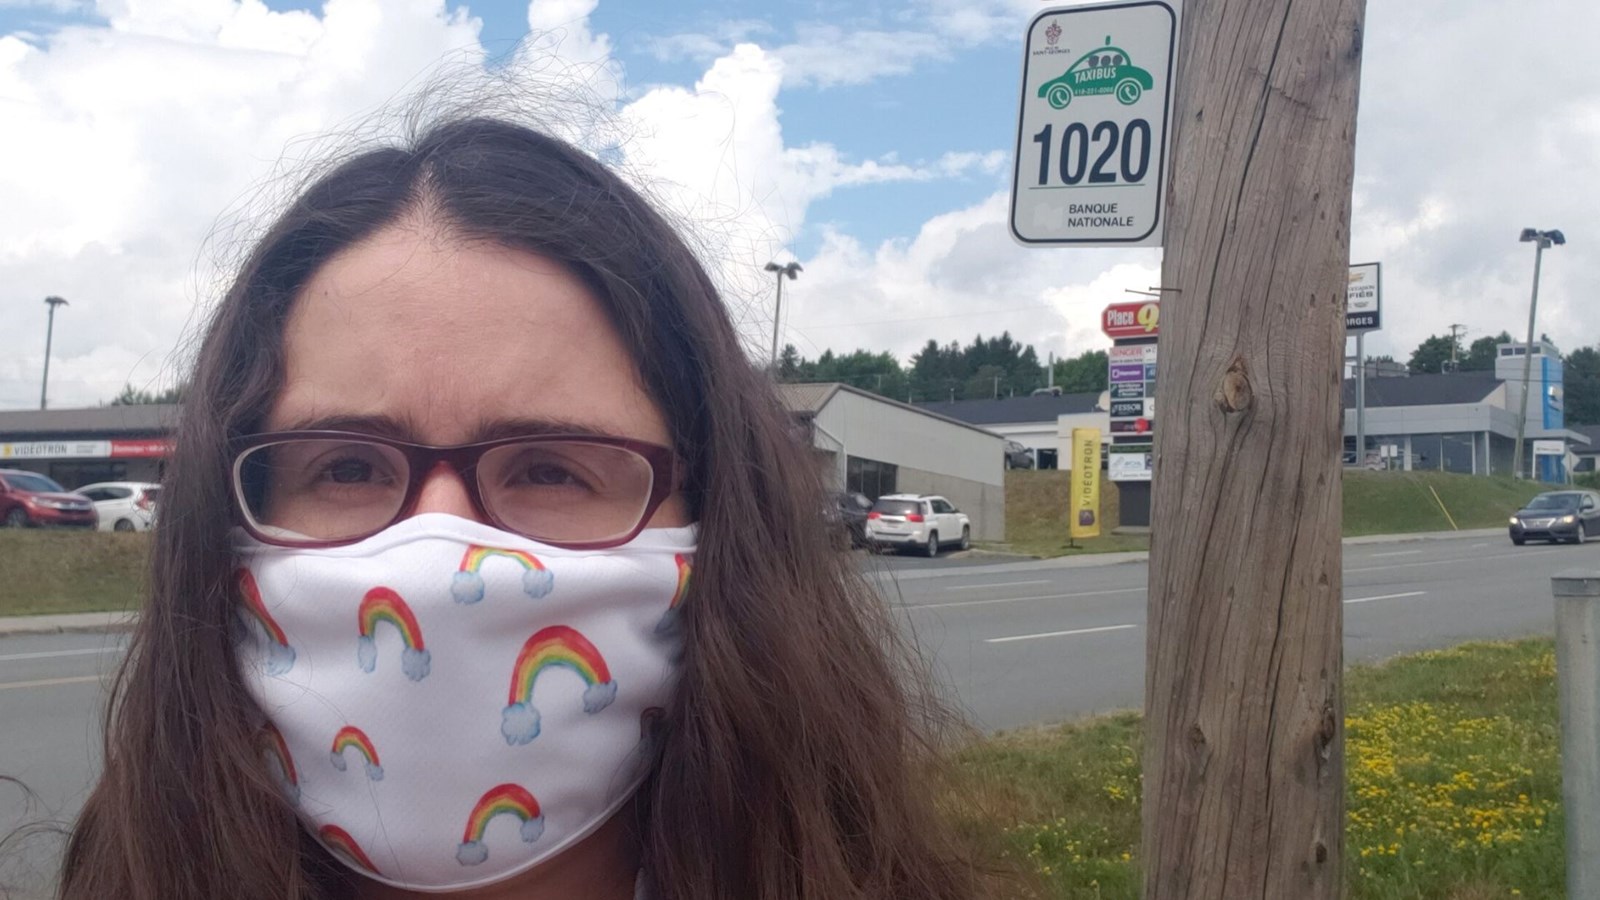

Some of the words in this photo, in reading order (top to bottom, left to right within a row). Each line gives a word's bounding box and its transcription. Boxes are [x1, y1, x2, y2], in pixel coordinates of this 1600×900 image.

[1074, 67, 1117, 84] TAXIBUS
[1033, 118, 1151, 185] 1020
[1069, 203, 1118, 214] BANQUE
[1067, 216, 1134, 227] NATIONALE
[1107, 310, 1134, 326] Place
[1137, 303, 1160, 332] 9
